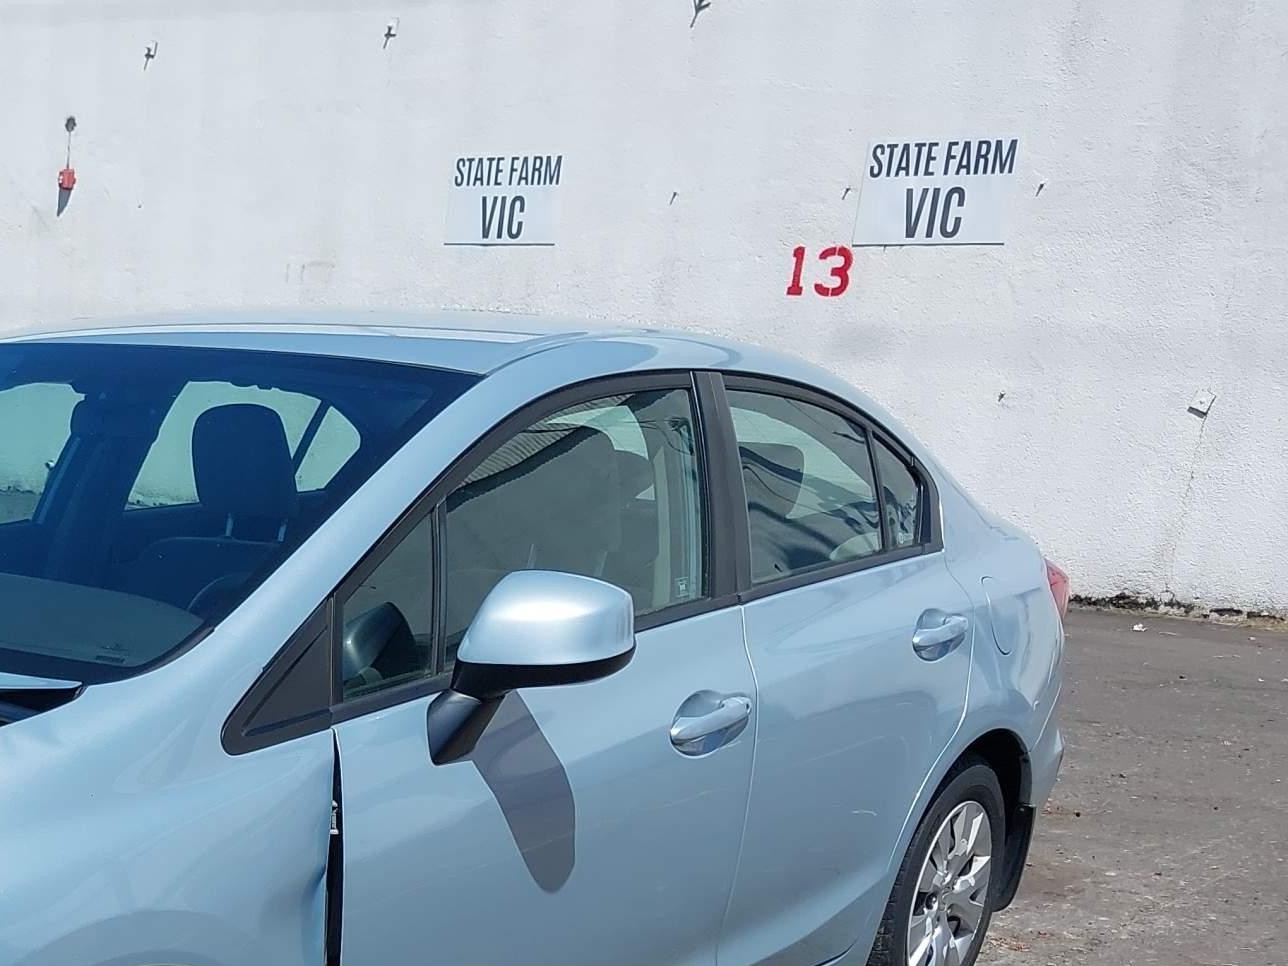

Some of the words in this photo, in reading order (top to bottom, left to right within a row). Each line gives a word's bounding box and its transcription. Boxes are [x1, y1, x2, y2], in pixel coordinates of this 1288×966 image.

[454, 156, 505, 187] STATE
[508, 155, 563, 186] FARM
[869, 142, 940, 178] STATE
[943, 139, 1019, 176] FARM
[481, 195, 526, 240] VIC
[904, 186, 966, 239] VIC
[786, 245, 854, 297] 13
